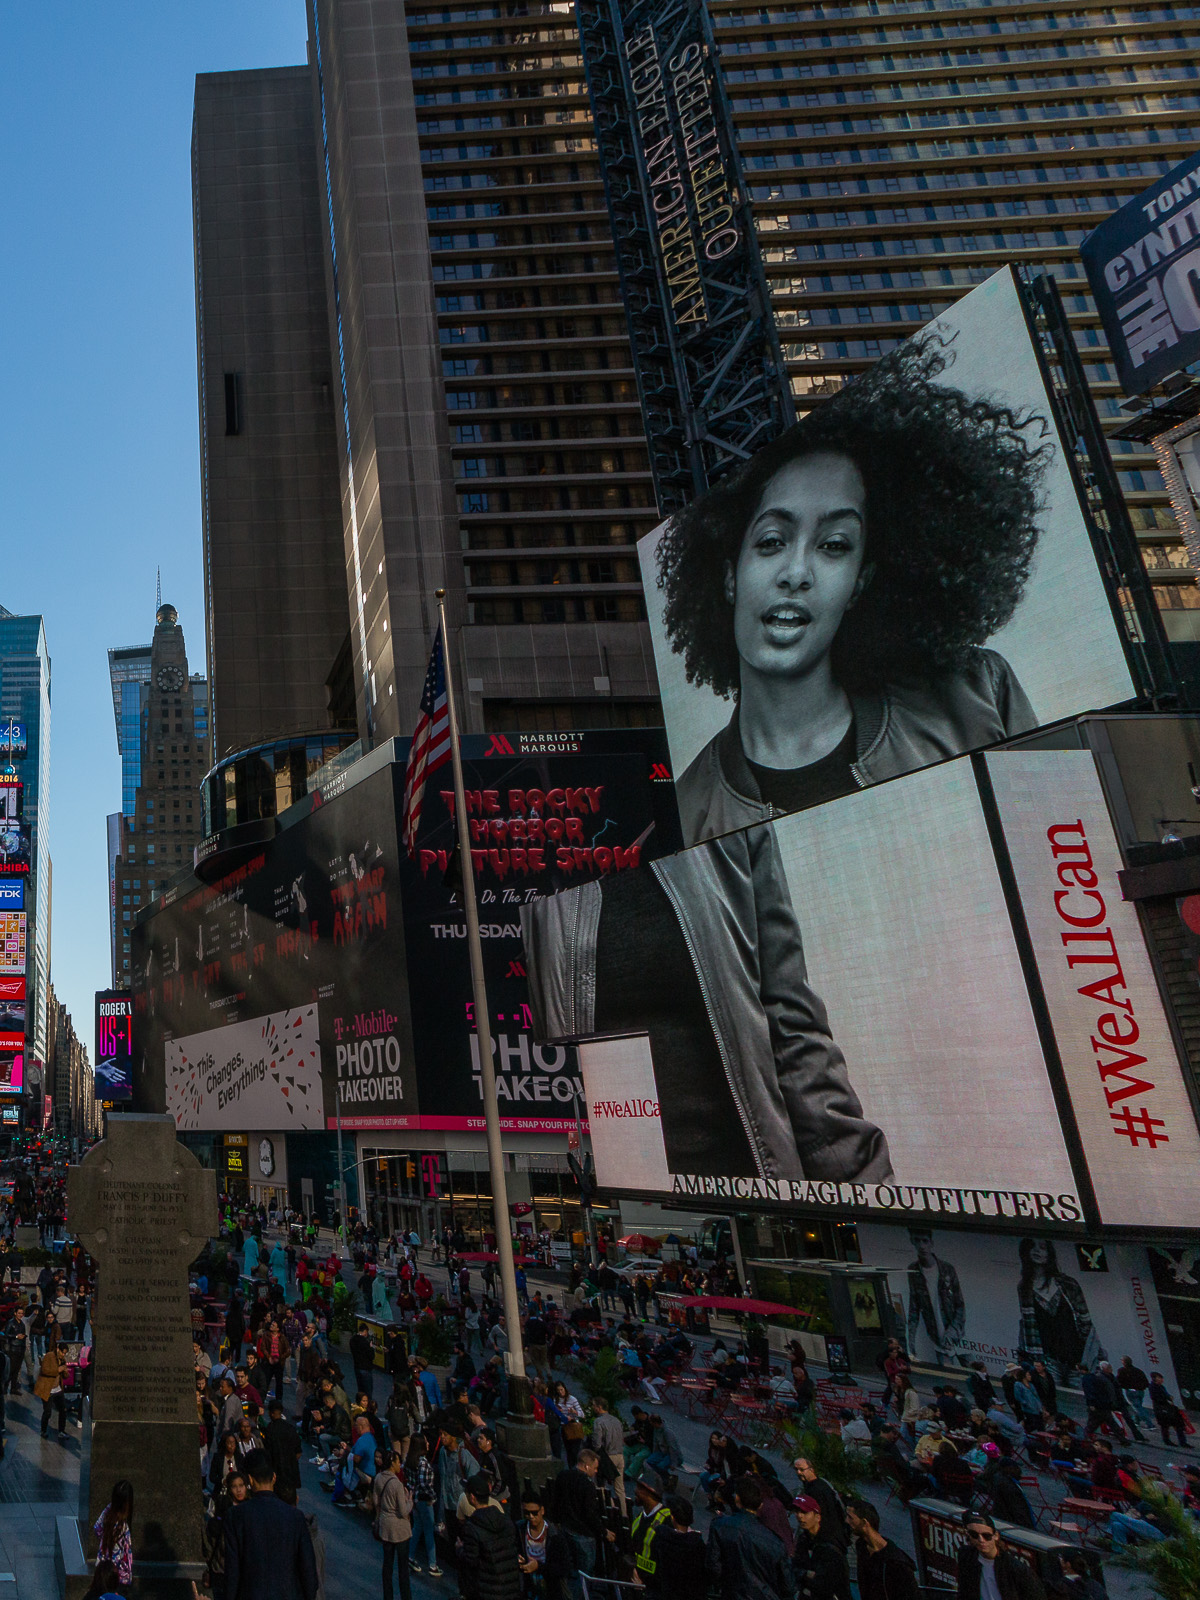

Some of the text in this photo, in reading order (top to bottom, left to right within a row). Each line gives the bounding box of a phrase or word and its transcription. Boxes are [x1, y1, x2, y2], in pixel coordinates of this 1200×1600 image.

[669, 42, 739, 260] OUTFITTERS
[626, 25, 709, 326] AMERICAN EAGLE
[519, 732, 585, 742] MARRIOTT
[521, 743, 579, 753] MARQUIS
[322, 772, 348, 793] MARRIOTT
[323, 783, 345, 802] MARQUIS
[508, 786, 604, 817] ROCKY
[470, 818, 584, 847] HORROR
[329, 856, 342, 867] LET'S
[330, 868, 348, 881] DO THE
[419, 846, 642, 881] PITURE SHOW
[481, 888, 521, 904] Do The
[1046, 818, 1169, 1149] #WeAllCan
[99, 1002, 126, 1016] ROGER
[99, 1016, 117, 1056] US
[197, 1053, 215, 1079] This.
[336, 1036, 401, 1077] PHOTO
[207, 1052, 244, 1094] Changes.
[218, 1057, 268, 1110] Everything.
[338, 1076, 403, 1103] TAKEOVER
[467, 1119, 563, 1129] STEP SNAP YOUR
[98, 1191, 188, 1203] FRANCIS DUFFY
[104, 1181, 145, 1189] LIEUTENANT
[672, 1173, 1082, 1223] AMERICAN EAGLE OUTFITTERS
[109, 1217, 176, 1226] CATHOLIC PRIEST
[1131, 1276, 1161, 1365] #WeAllCan
[944, 1337, 1008, 1358] AMERICAN
